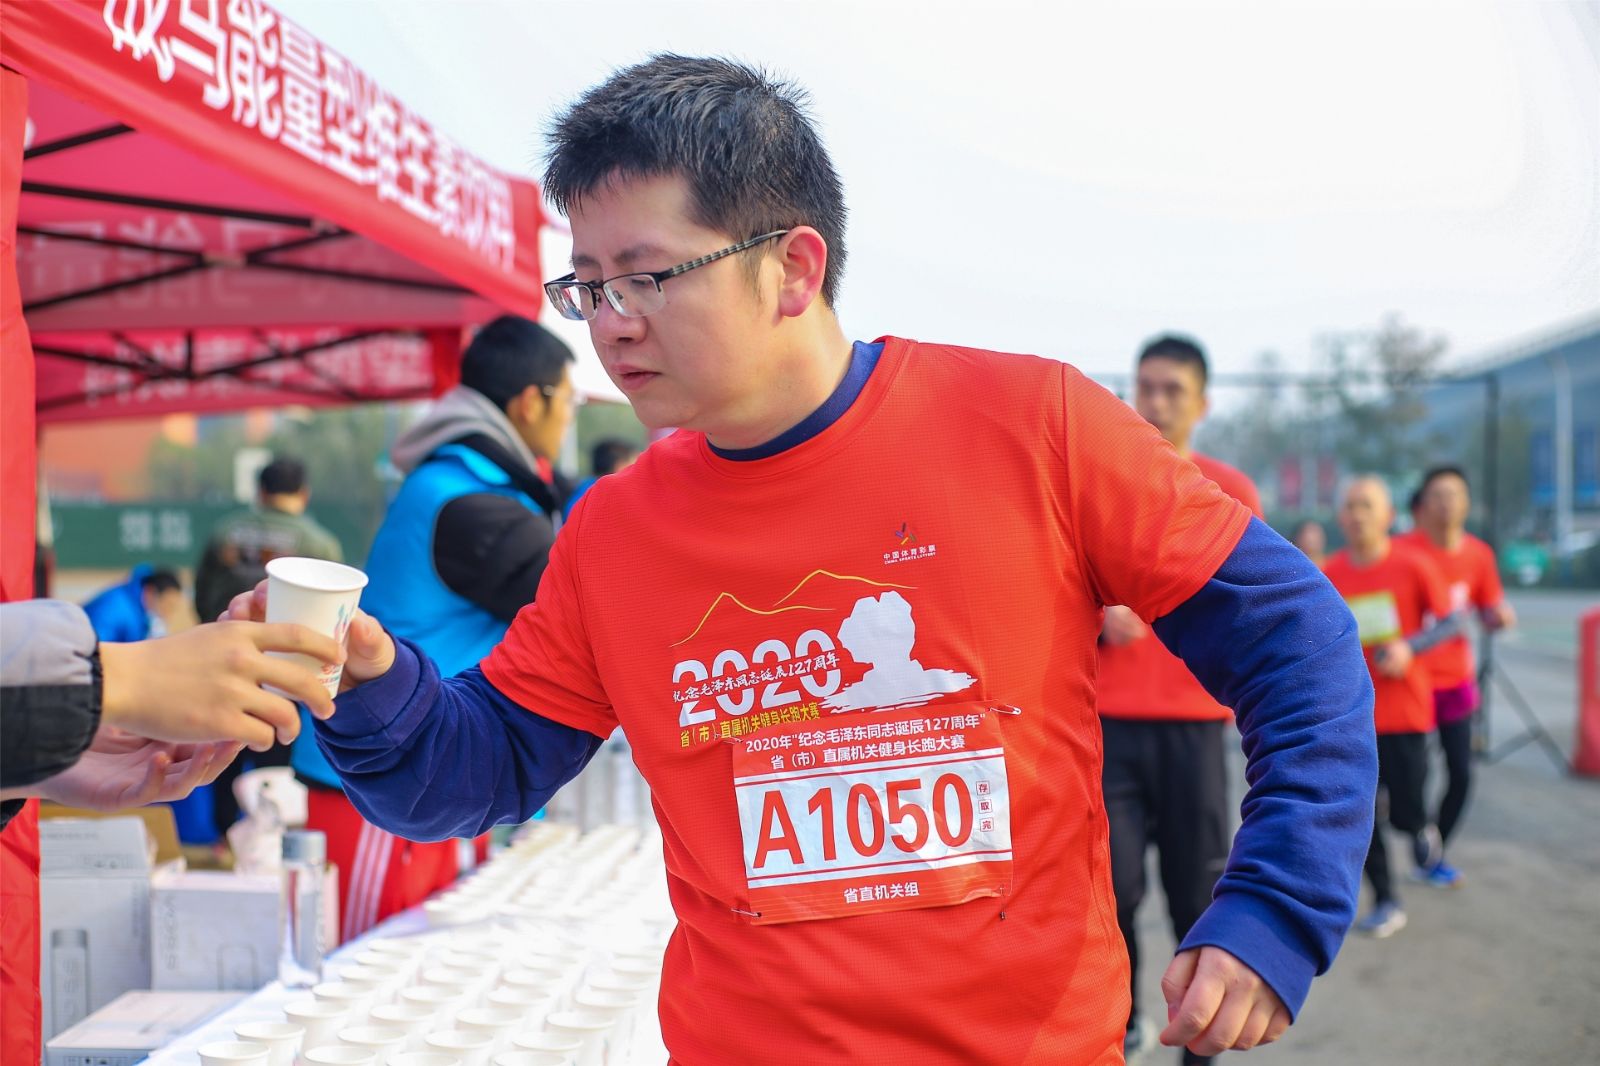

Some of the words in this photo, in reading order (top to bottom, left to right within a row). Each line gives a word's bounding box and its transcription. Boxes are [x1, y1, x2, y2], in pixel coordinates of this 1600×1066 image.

[883, 544, 936, 561] 中国体育彩票
[672, 629, 842, 728] 2020
[673, 651, 841, 703] 纪念毛泽东同志诞辰127周年
[752, 772, 974, 869] A1050
[843, 881, 920, 904] 省直机关组
